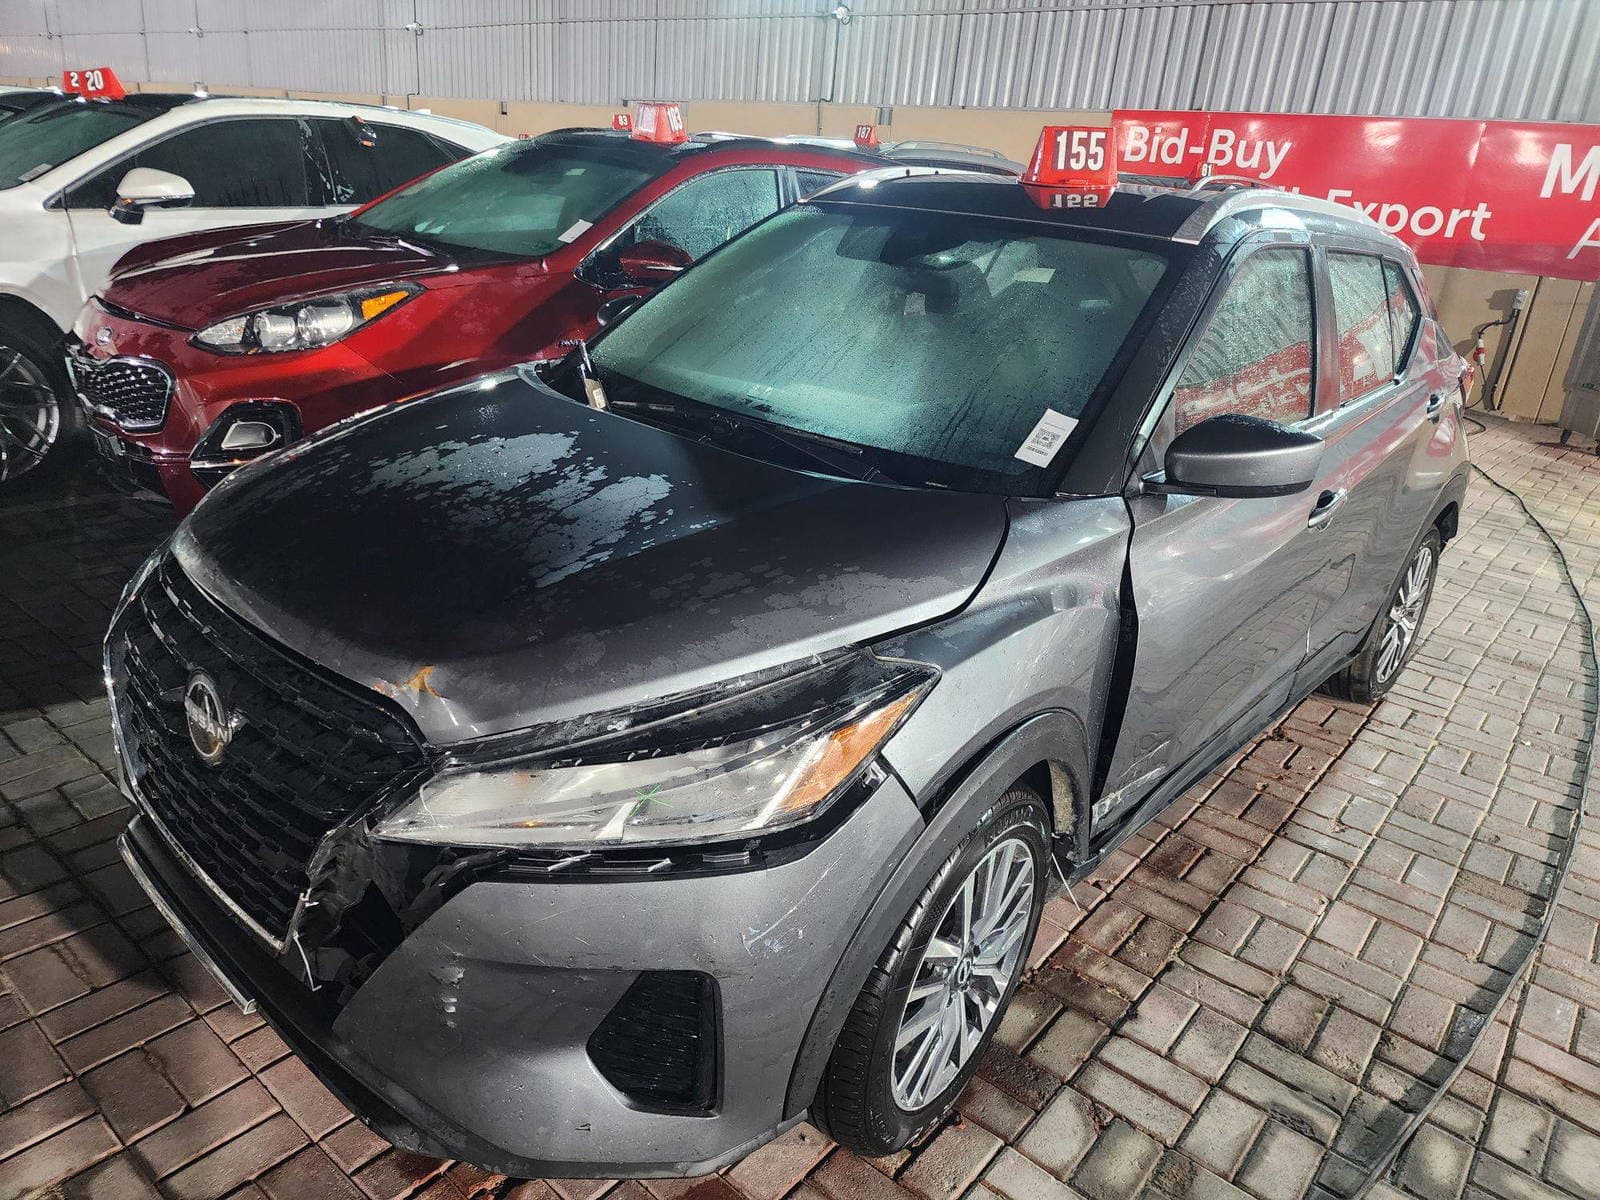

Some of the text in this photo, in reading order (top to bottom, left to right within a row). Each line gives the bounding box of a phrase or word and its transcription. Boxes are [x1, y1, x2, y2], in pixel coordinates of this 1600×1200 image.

[85, 70, 104, 91] 20
[857, 127, 871, 138] 187
[1057, 131, 1106, 170] 155
[1123, 126, 1292, 180] Bid-Buy
